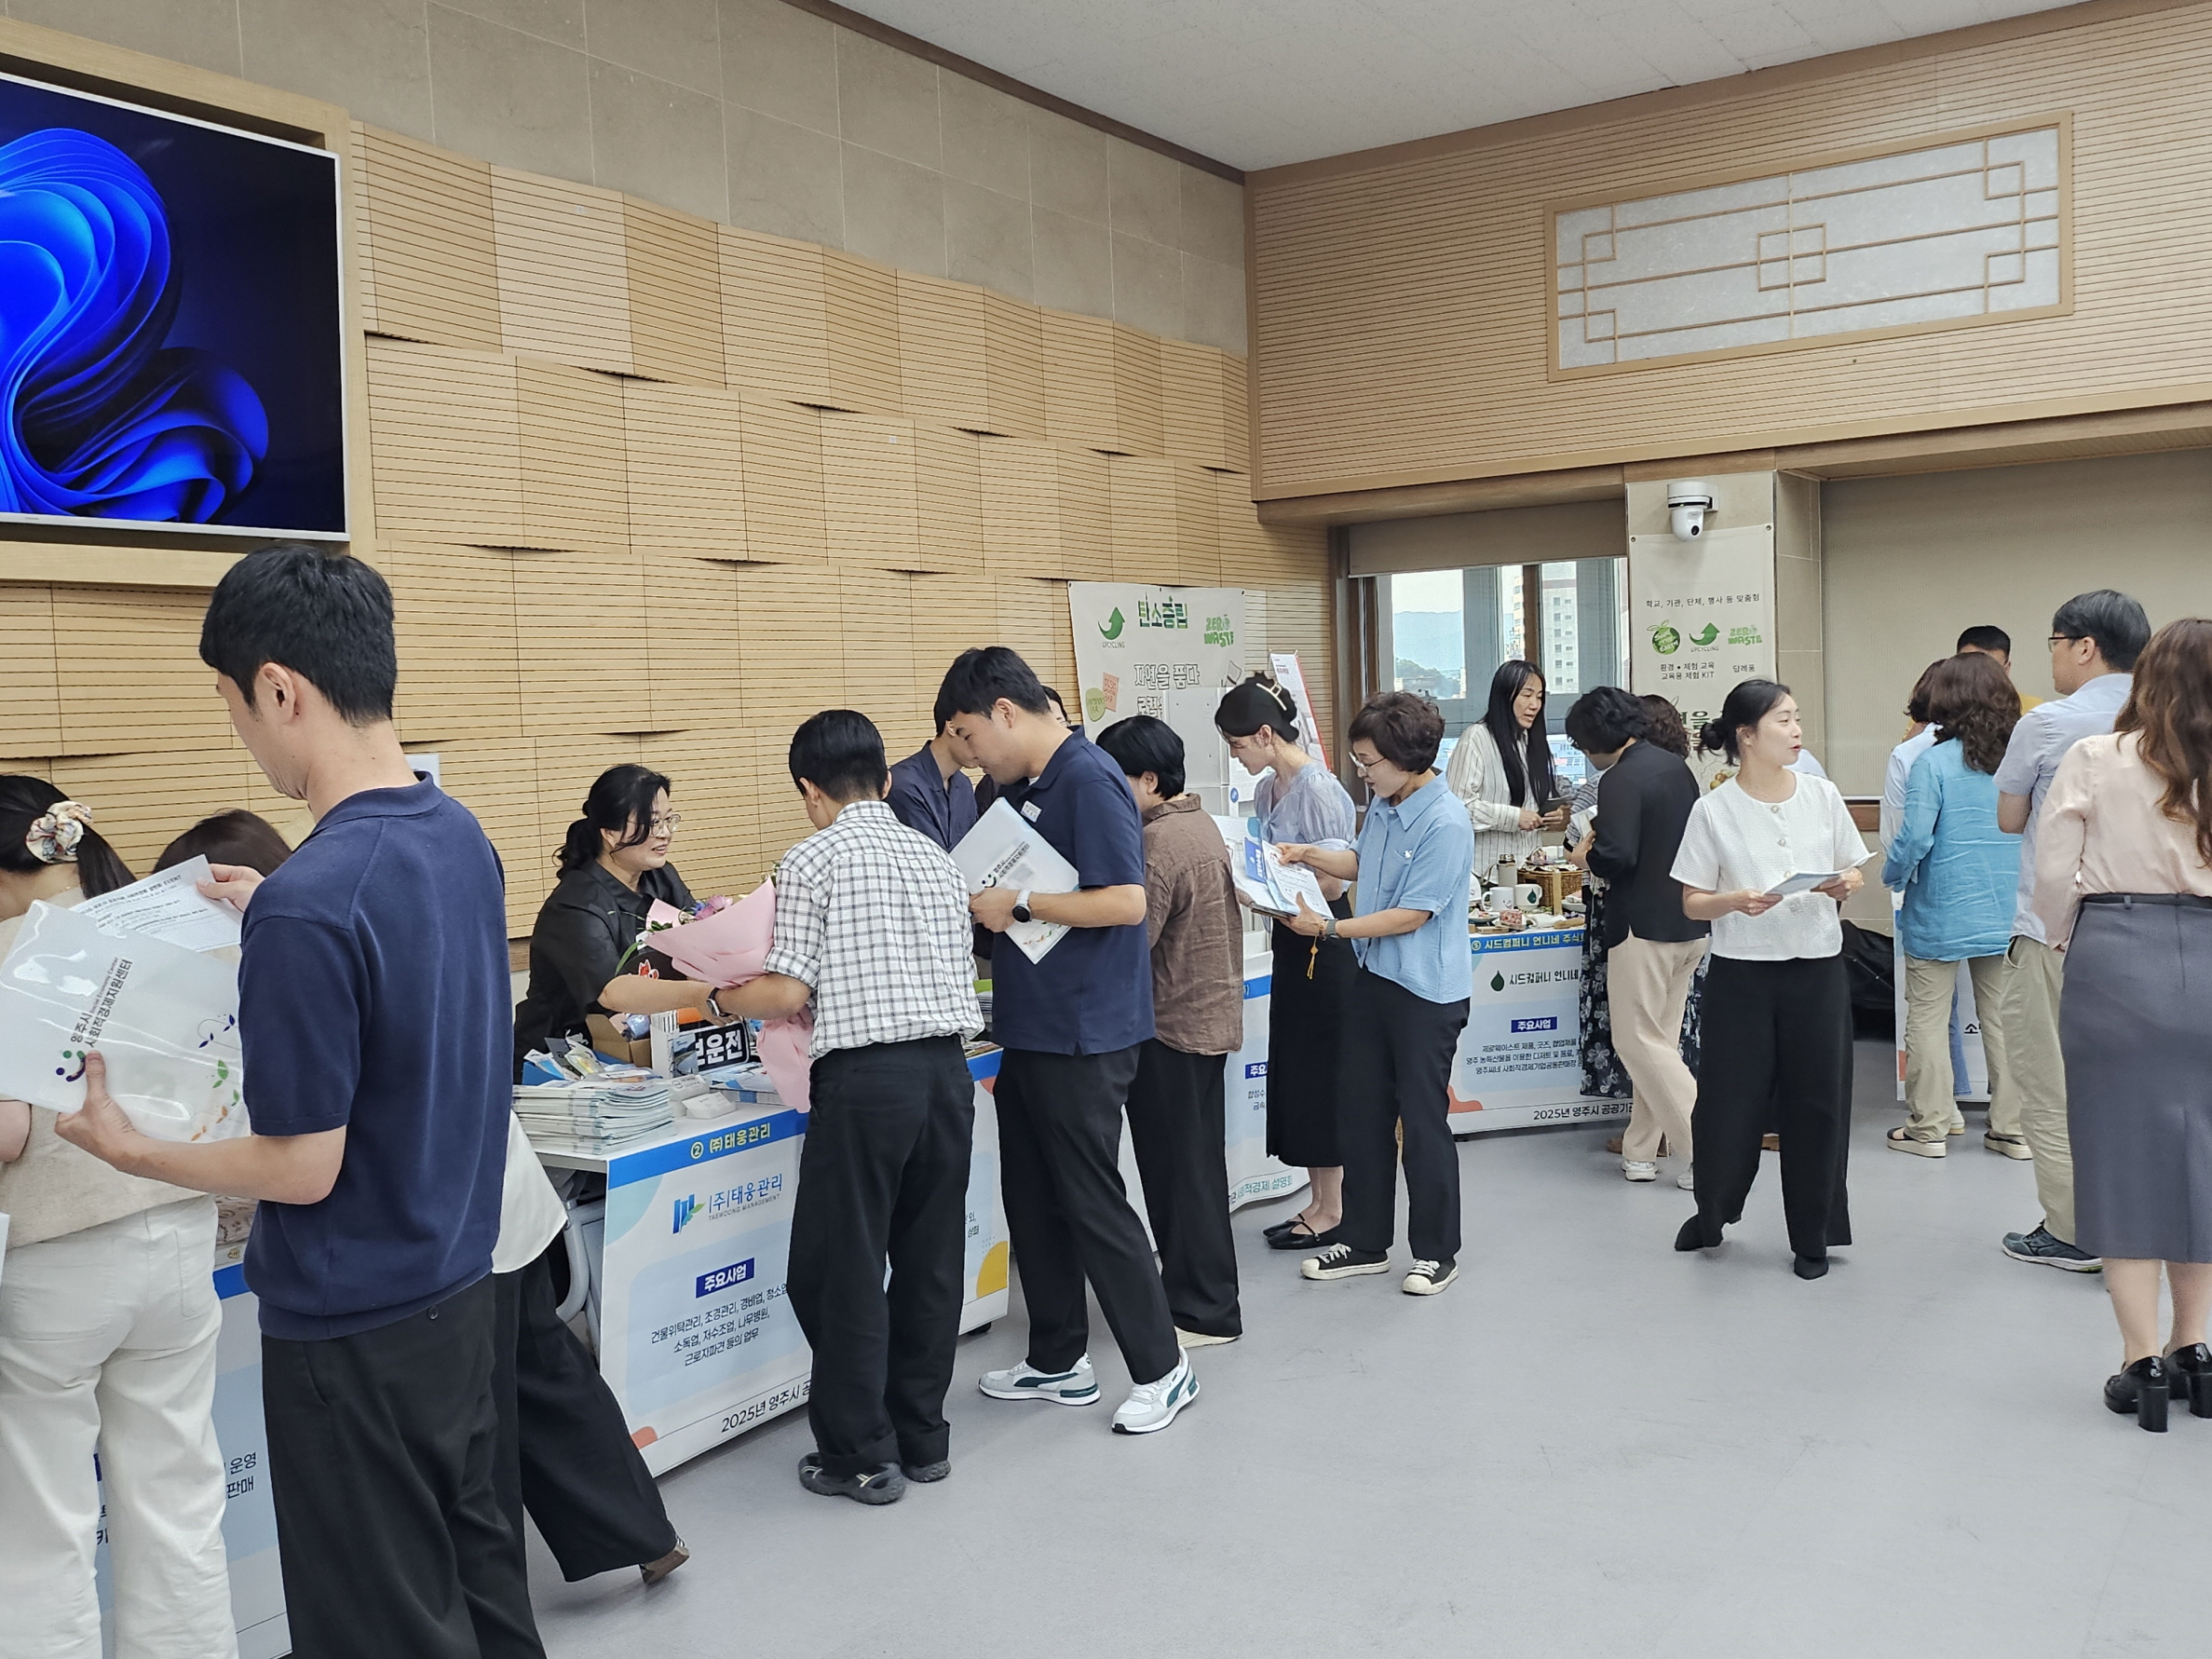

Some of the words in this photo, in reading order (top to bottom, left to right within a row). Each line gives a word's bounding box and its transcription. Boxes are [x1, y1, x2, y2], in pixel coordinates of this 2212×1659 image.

[1138, 592, 1188, 629] 탄소중립
[1647, 600, 1663, 608] 학교,
[1666, 599, 1684, 607] 기관,
[1687, 597, 1704, 606] 단체,
[1708, 596, 1723, 605] 행사
[1727, 595, 1732, 604] 등
[1206, 614, 1230, 632] ZERO
[1730, 625, 1757, 636] ZERO
[1204, 632, 1234, 647] WASTE
[1728, 635, 1762, 646] WASTE
[1684, 662, 1698, 671] 체험
[1701, 661, 1714, 670] 교육
[1732, 664, 1755, 673] 답례품
[1133, 663, 1170, 690] 자연을
[1174, 663, 1200, 689] 품다
[1686, 672, 1699, 680] 체험
[1485, 937, 1529, 949] 시드컴퍼니
[1533, 934, 1559, 946] 언니네
[1509, 972, 1551, 986] 시드컴퍼니
[1554, 969, 1579, 982] 언니네
[71, 1012, 92, 1043] 영주시
[97, 975, 112, 999] Economy
[107, 958, 118, 974] Center
[85, 959, 132, 1048] 사회적경제지원센터
[1517, 1019, 1552, 1030] 주요사업
[1466, 1057, 1479, 1066] 영주
[1513, 1053, 1531, 1061] 이용한
[1533, 1052, 1552, 1060] 디저트
[1533, 1108, 1570, 1120] 2025년
[1572, 1106, 1599, 1118] 영주시
[709, 1207, 740, 1221] TAEWOONG
[742, 1194, 780, 1211] MANAGEMENT
[704, 1263, 747, 1291] 주요사업
[652, 1315, 703, 1344] 건물위탁관리,
[704, 1302, 740, 1325] 조경관리,
[740, 1291, 766, 1311] 경비업,
[673, 1334, 700, 1353] 소독업,
[702, 1320, 736, 1342] 저수조업,
[738, 1307, 770, 1328] 나무병원,
[685, 1340, 725, 1367] 근로자파견
[726, 1334, 742, 1350] 등의
[744, 1327, 759, 1343] 업무
[721, 1400, 766, 1433] 2025년
[769, 1384, 799, 1410] 영주시
[229, 1451, 257, 1475] 운영
[227, 1475, 254, 1500] 판매
